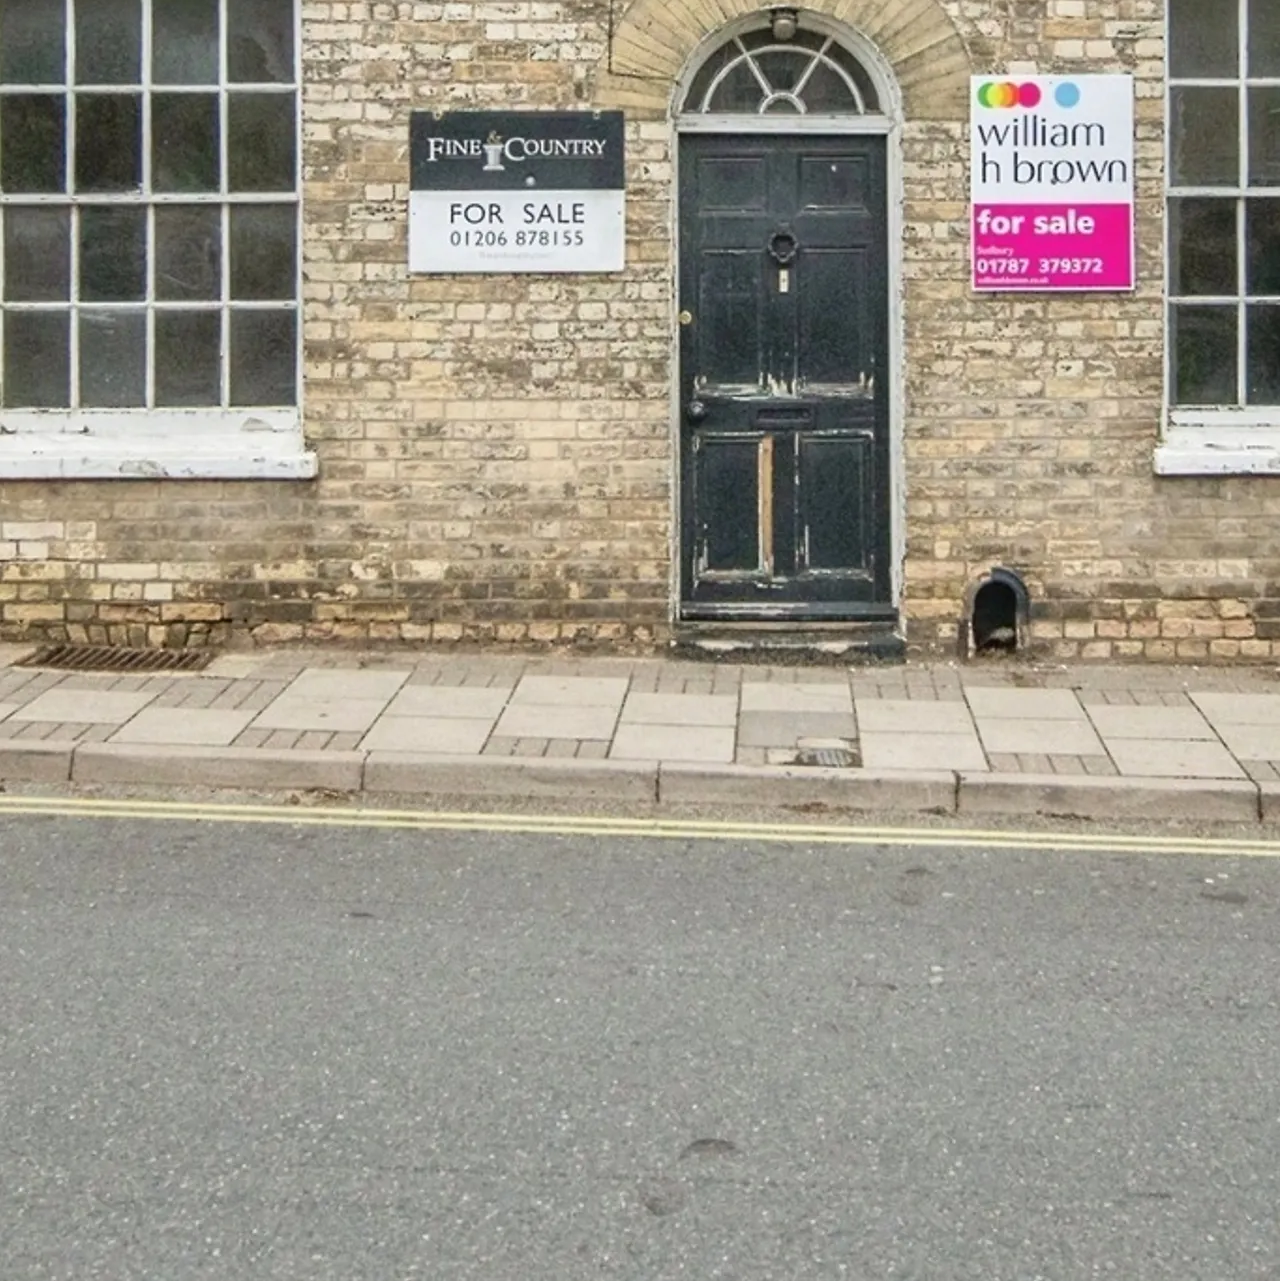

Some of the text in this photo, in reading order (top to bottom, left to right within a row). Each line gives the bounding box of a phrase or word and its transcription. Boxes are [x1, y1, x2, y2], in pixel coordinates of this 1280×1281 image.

[977, 114, 1105, 147] william
[426, 137, 482, 162] FINE
[504, 136, 607, 162] COUNTRY
[981, 151, 1127, 184] h brown
[450, 203, 585, 224] FOR SALE
[977, 209, 1095, 234] for sale
[450, 230, 584, 247] 01206 878155
[977, 258, 1103, 274] 01787 379372
